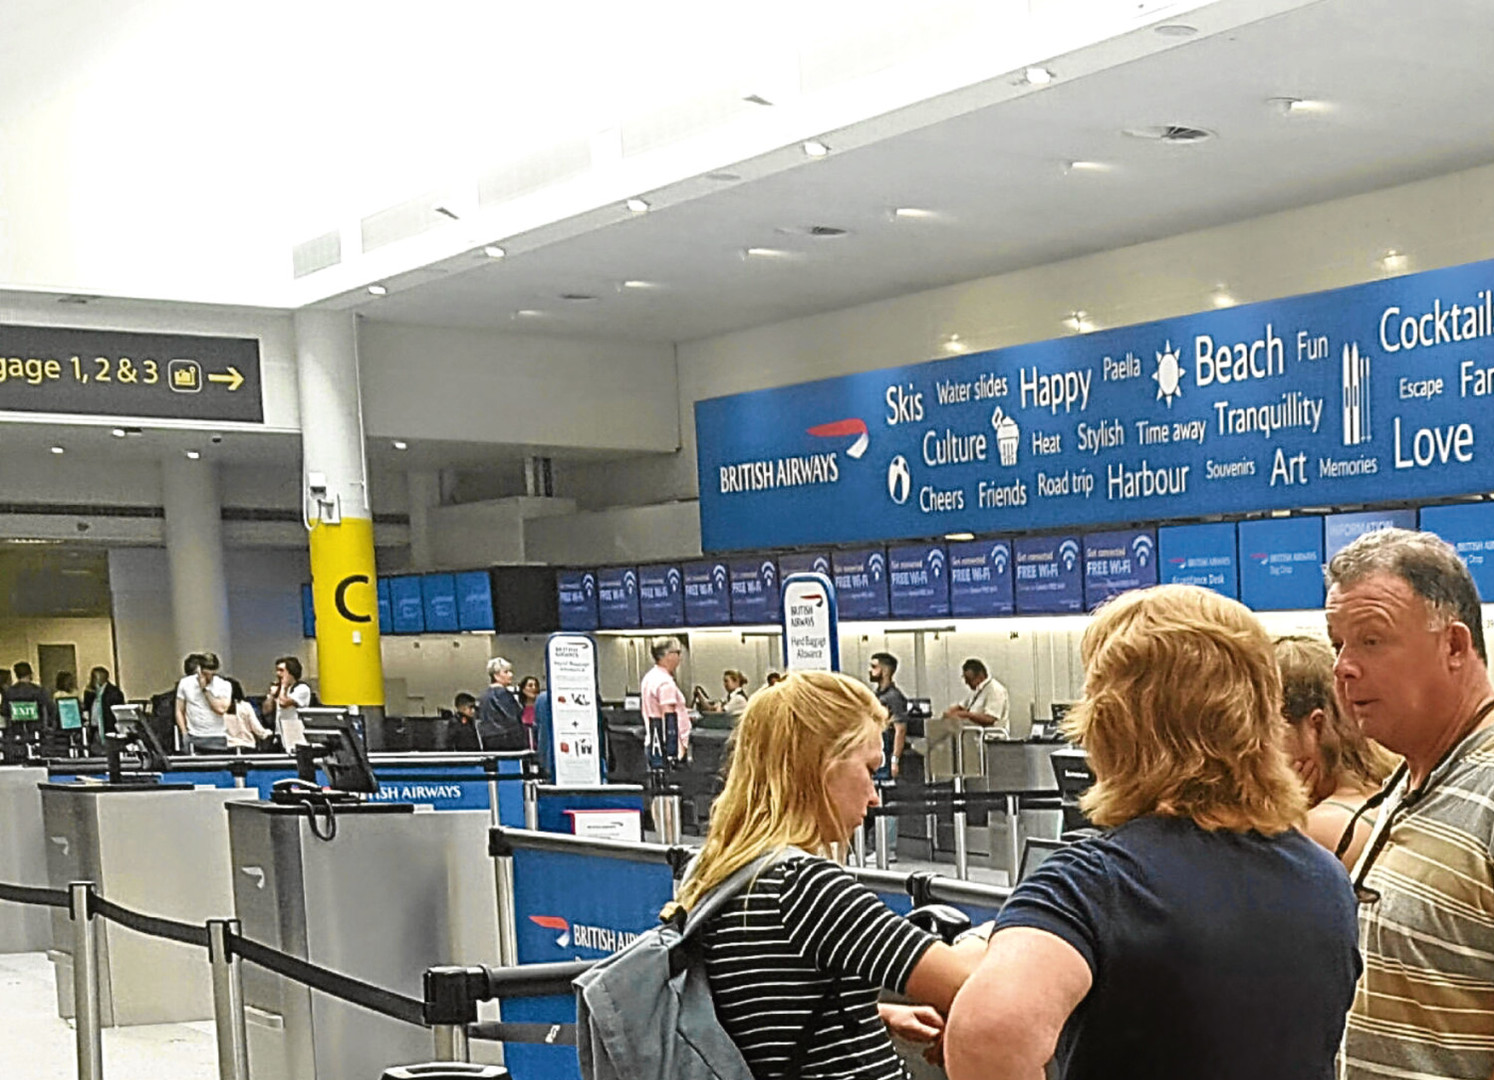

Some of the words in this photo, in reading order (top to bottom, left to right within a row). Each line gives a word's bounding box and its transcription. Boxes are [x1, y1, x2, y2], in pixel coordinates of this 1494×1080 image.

[1195, 323, 1284, 386] Beach
[1297, 331, 1328, 361] Fun
[71, 356, 88, 384] 1,
[94, 358, 111, 379] 2
[117, 360, 138, 381] &
[143, 361, 158, 383] 3
[1103, 353, 1141, 381] Paella
[936, 380, 971, 405] Water
[975, 373, 1008, 400] slides
[1020, 366, 1092, 414] Happy
[1400, 376, 1443, 400] Escape
[886, 384, 923, 425] Skis
[1214, 391, 1323, 438] Tranquillity
[923, 429, 986, 466] Culture
[1032, 431, 1061, 456] Heat
[1077, 419, 1125, 454] Stylish
[1136, 421, 1169, 445] Time
[1172, 419, 1206, 447] away
[1394, 417, 1474, 468] Love
[720, 461, 774, 493] BRITISH
[776, 453, 839, 487] AIRWAYS
[1108, 460, 1189, 500] Harbour
[1205, 457, 1255, 479] Souvenirs
[1270, 448, 1308, 487] Art
[1319, 455, 1378, 478] Memories
[978, 478, 1027, 510] Friends
[1038, 471, 1069, 497] Road
[1073, 468, 1093, 498] trip
[920, 485, 964, 513] Cheers
[1087, 561, 1108, 575] FREE
[335, 575, 371, 623] C
[401, 785, 461, 799] AIRWAYS
[573, 924, 616, 952] BRITISH
